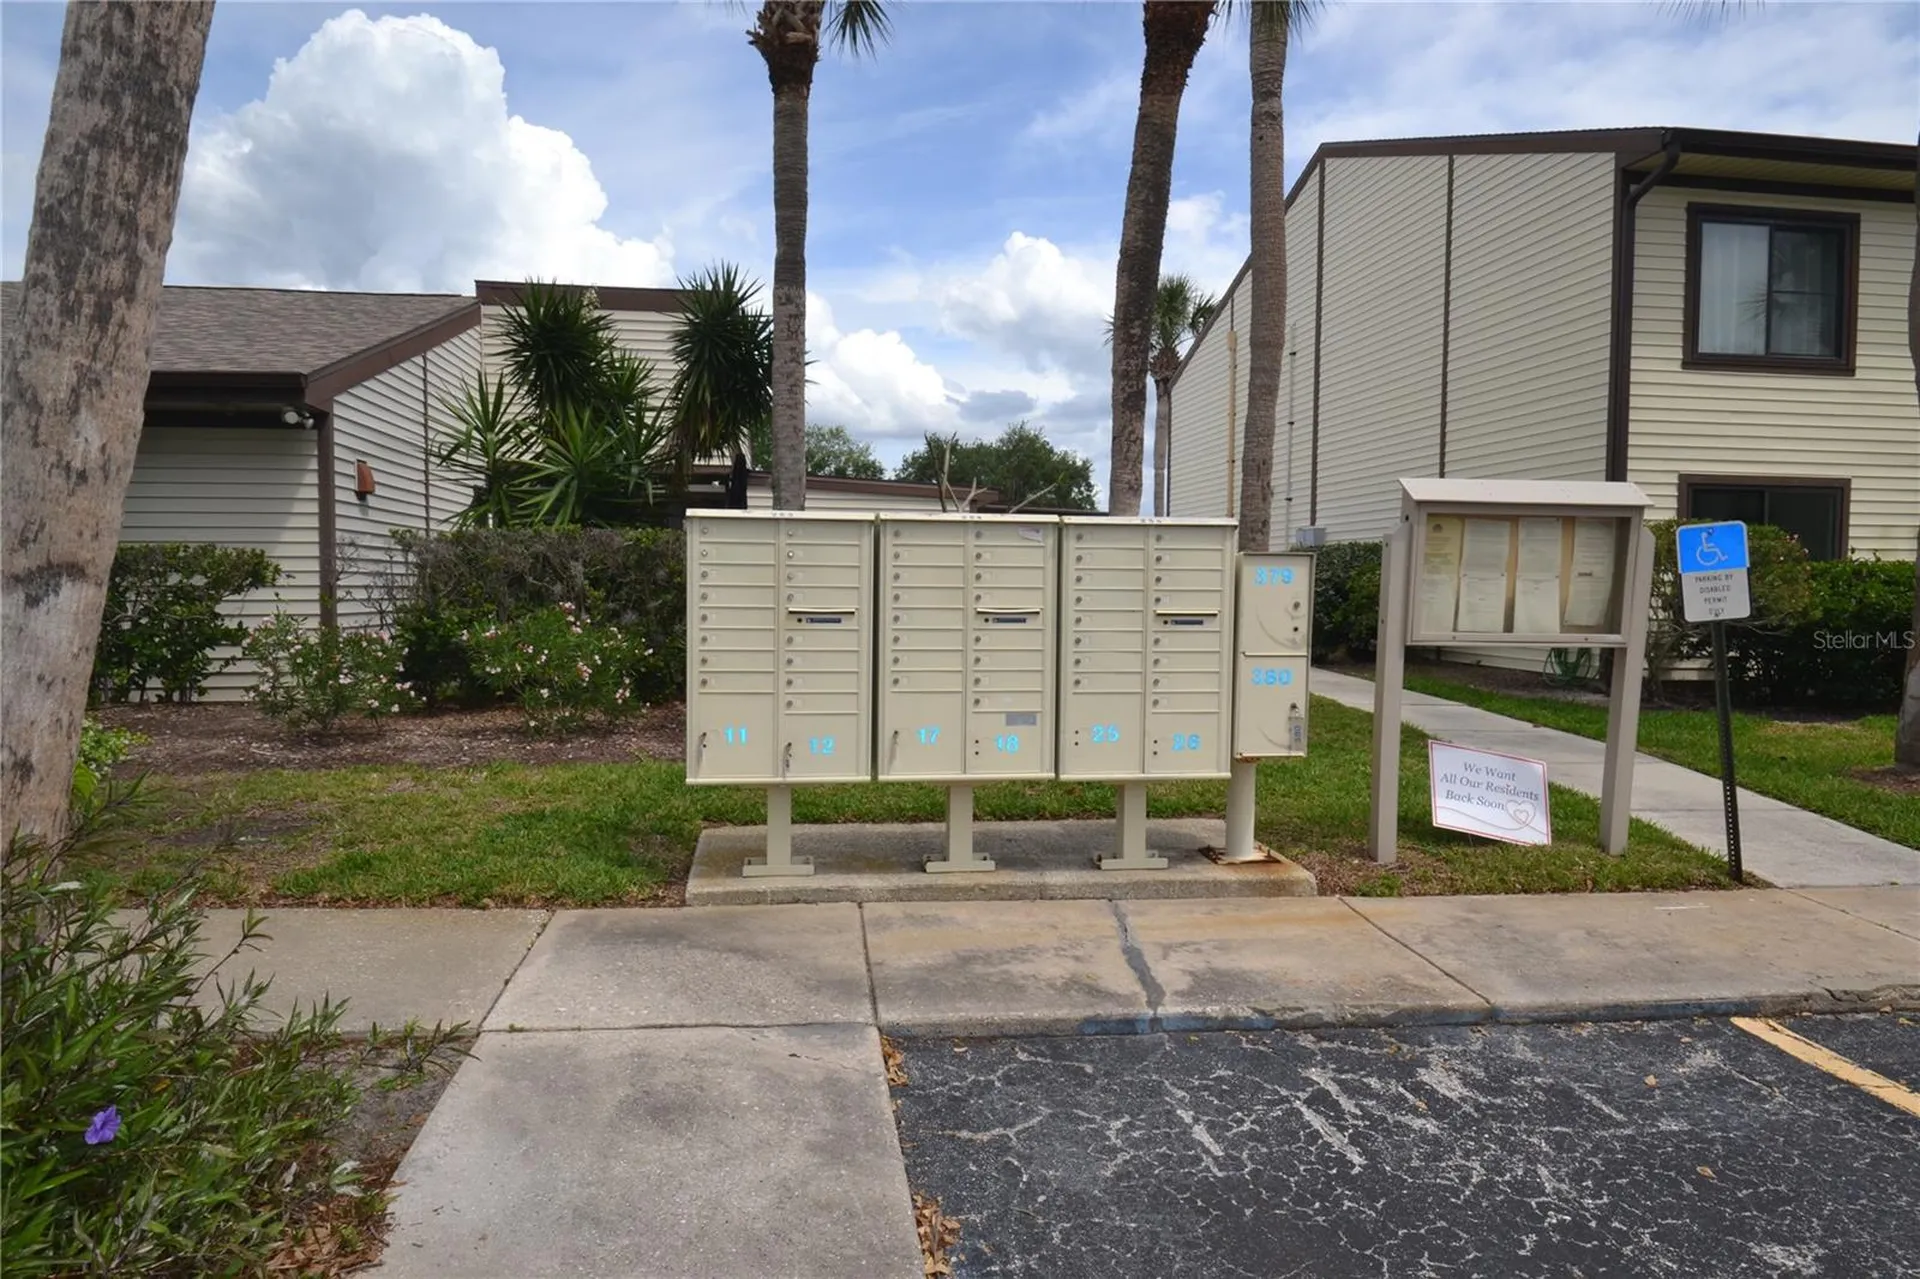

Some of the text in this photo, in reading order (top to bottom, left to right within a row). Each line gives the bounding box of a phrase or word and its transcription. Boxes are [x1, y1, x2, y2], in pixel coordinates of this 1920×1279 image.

[1254, 567, 1294, 585] 379
[1695, 575, 1722, 583] PARKING
[1699, 585, 1731, 594] DISABLED
[1704, 596, 1727, 604] PERMIT
[724, 726, 748, 744] 11
[917, 727, 941, 745] 17
[1091, 724, 1119, 743] 25
[1172, 733, 1200, 751] 26
[809, 737, 835, 755] 12
[995, 734, 1019, 754] 18
[1464, 761, 1516, 782] We Want
[1440, 773, 1540, 801] All Our Residents
[1445, 789, 1505, 811] Back Soon
